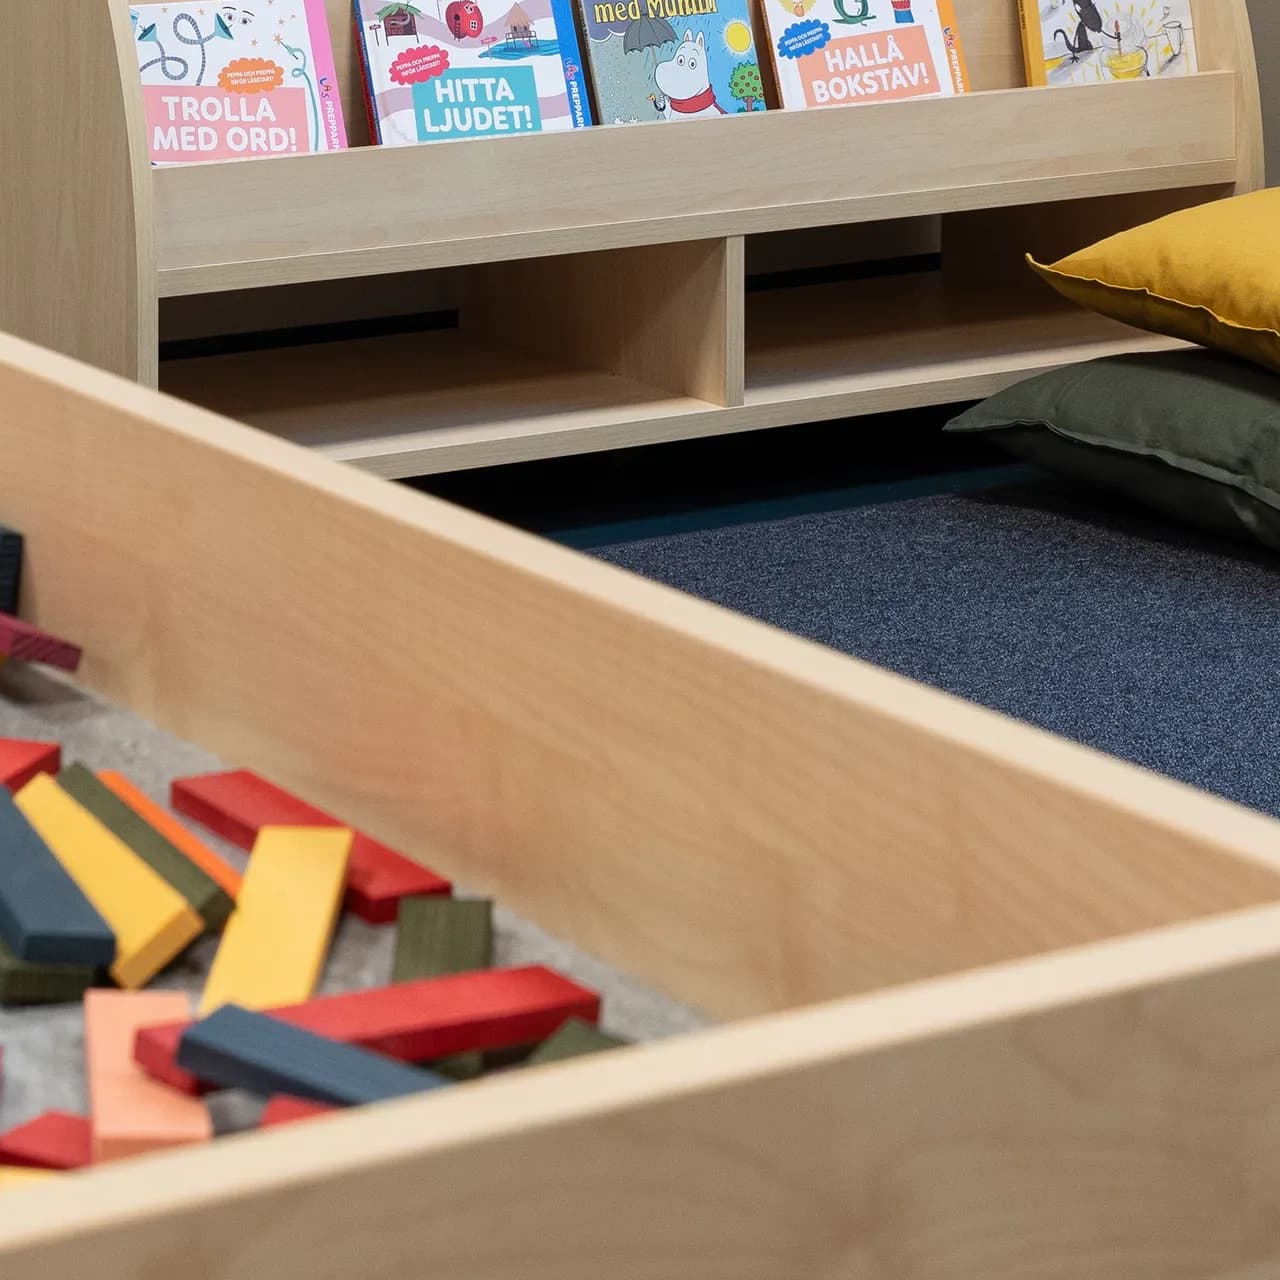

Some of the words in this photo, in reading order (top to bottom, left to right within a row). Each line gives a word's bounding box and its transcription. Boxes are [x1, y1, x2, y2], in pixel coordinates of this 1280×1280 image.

[824, 34, 905, 73] HALLÅ
[435, 77, 514, 103] HITTA
[811, 62, 930, 104] BOKSTAV!
[161, 96, 276, 122] TROLLA
[423, 105, 533, 133] LJUDET!
[153, 126, 218, 151] MED
[226, 126, 298, 152] ORD!
